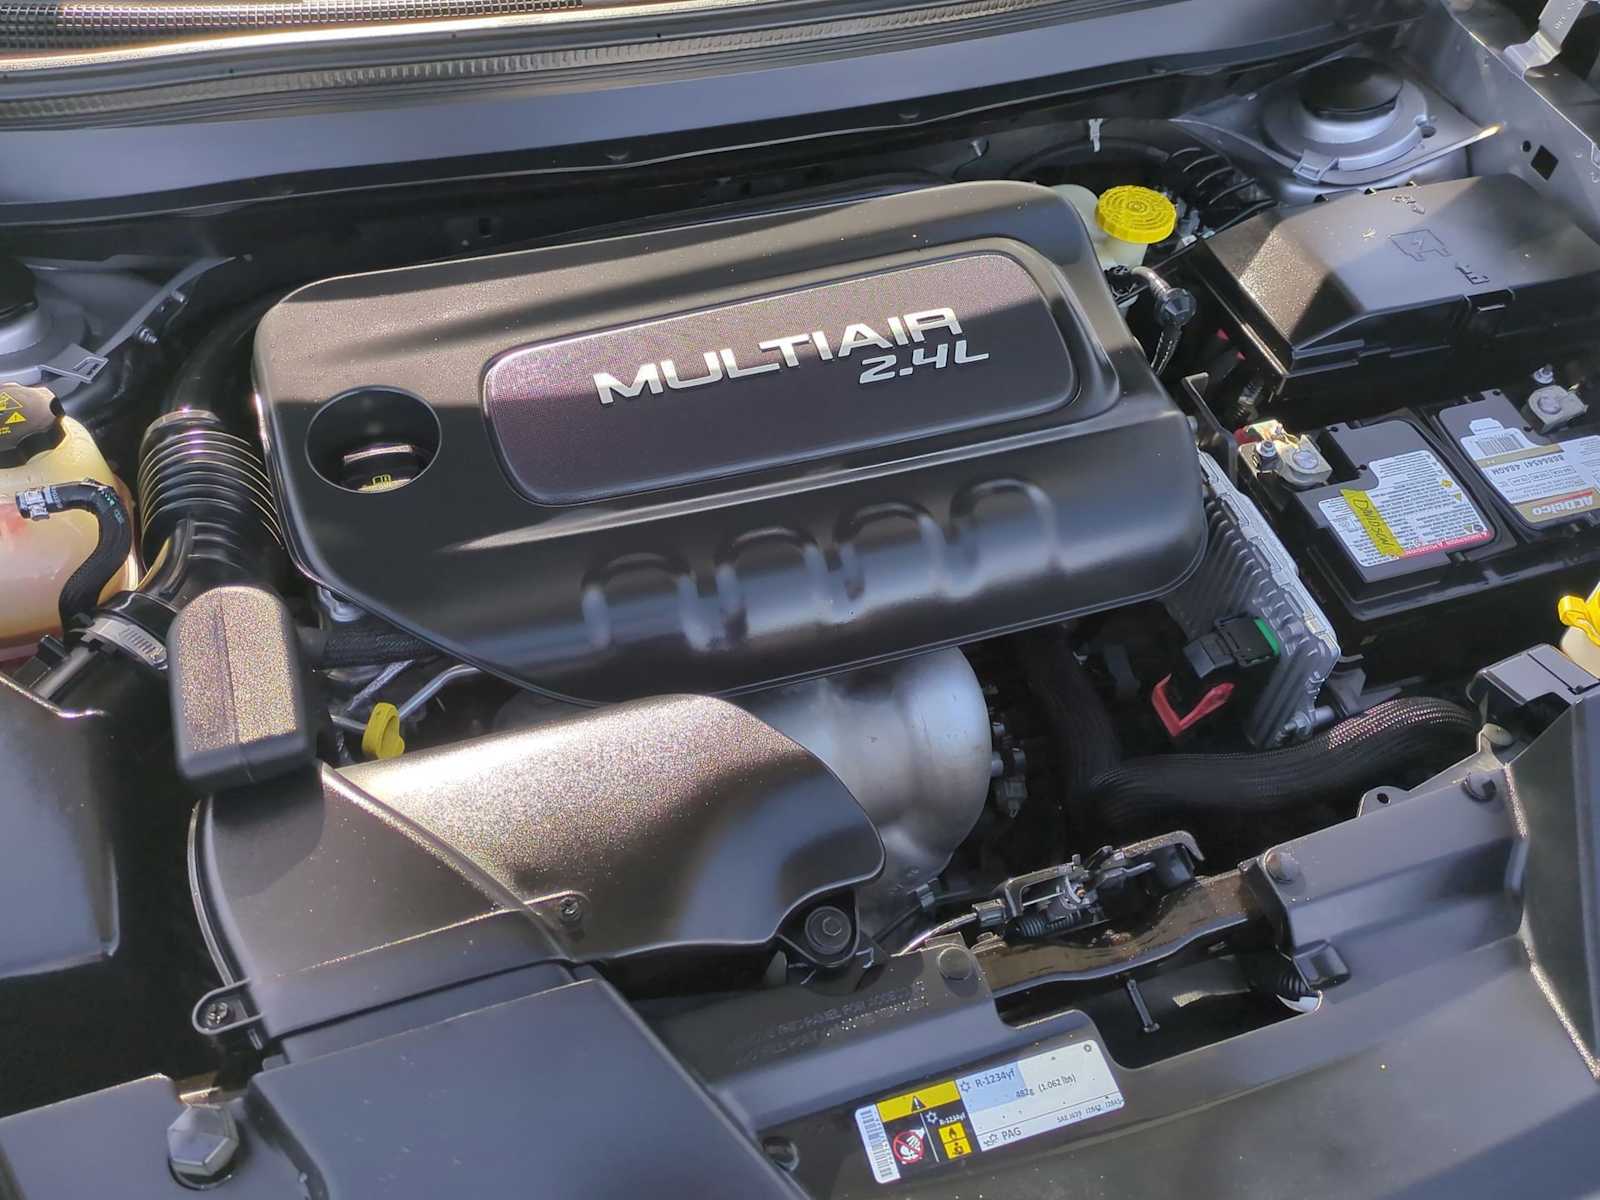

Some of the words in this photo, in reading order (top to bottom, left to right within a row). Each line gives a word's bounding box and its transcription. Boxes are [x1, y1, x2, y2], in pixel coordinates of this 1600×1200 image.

[592, 307, 962, 405] MULTIAIR
[859, 340, 990, 384] 2.4L
[975, 1068, 1015, 1088] R-1234yf
[1001, 1127, 1022, 1141] PAG
